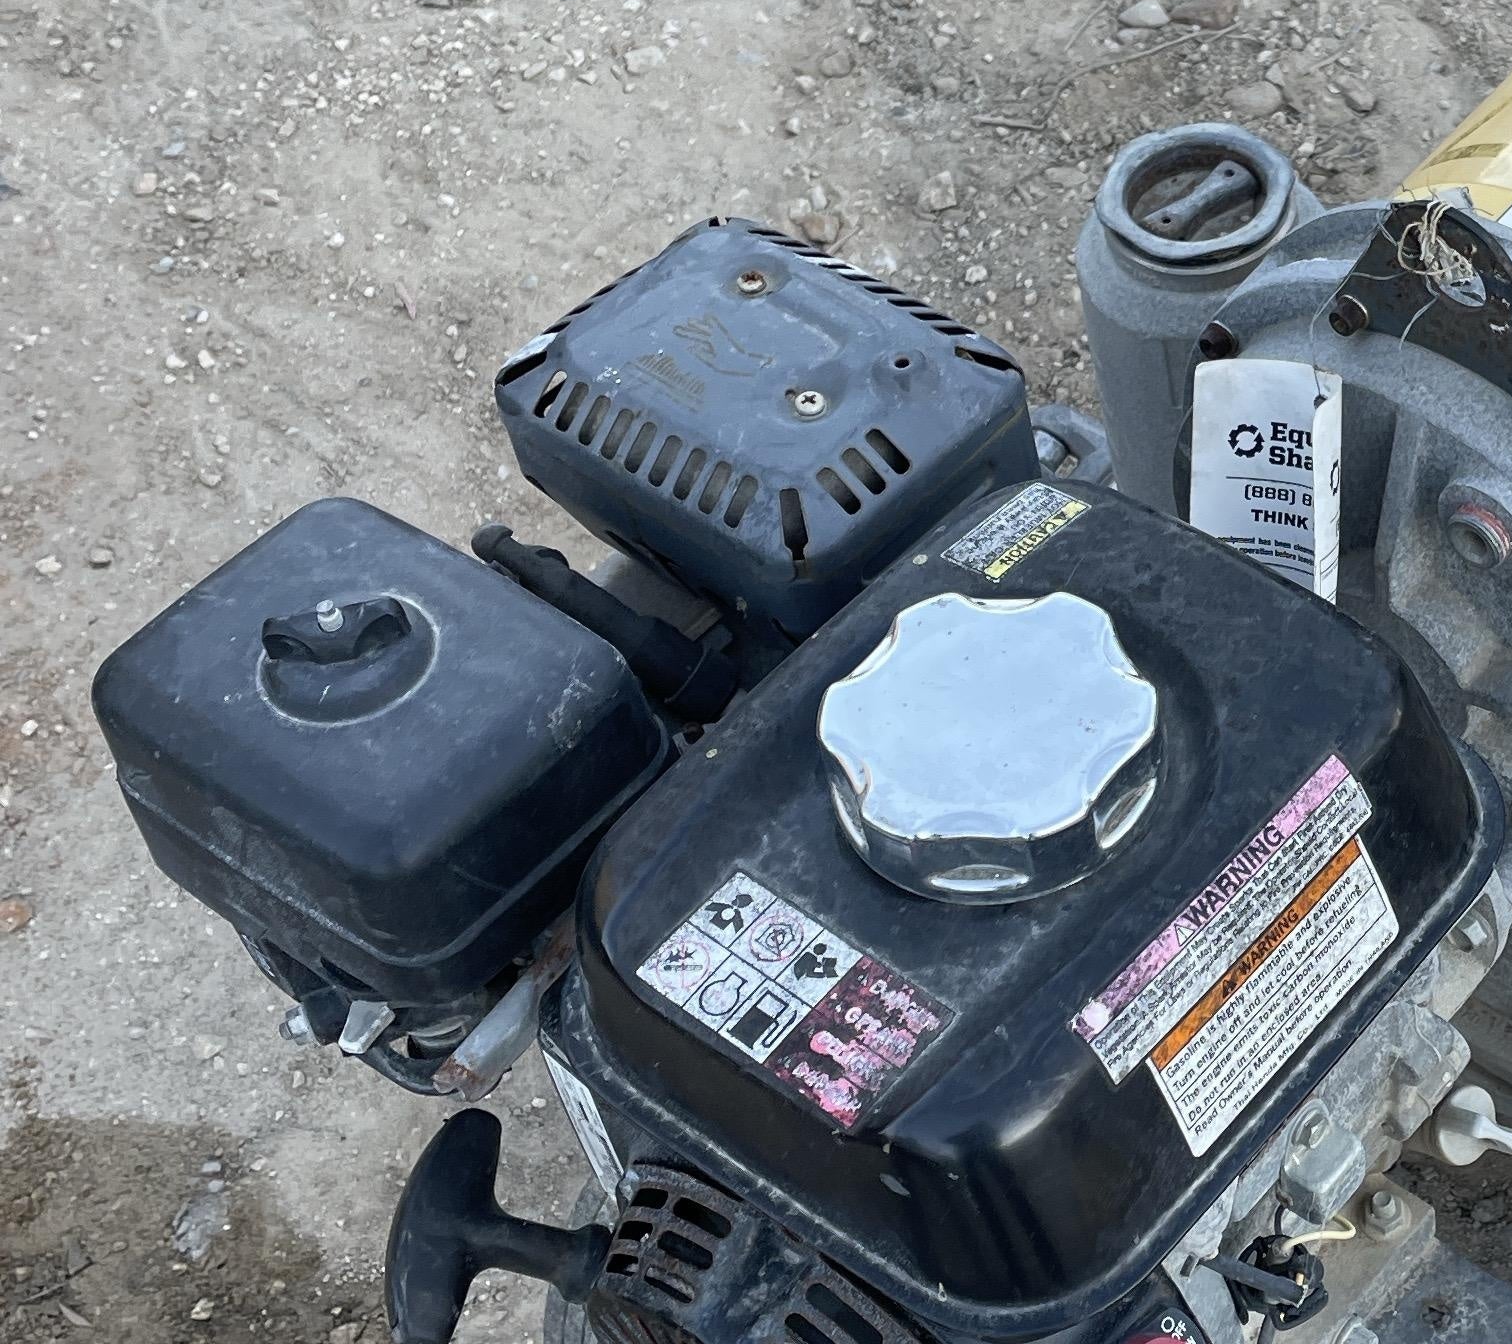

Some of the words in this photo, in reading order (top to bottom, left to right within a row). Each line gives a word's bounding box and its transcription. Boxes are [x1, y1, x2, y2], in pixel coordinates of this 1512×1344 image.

[996, 520, 1059, 567] CAUTION
[1245, 484, 1296, 506] (888)
[1251, 509, 1309, 531] THINK
[1183, 821, 1285, 931] WARNING
[1165, 1031, 1206, 1081] Gasoline
[1205, 1020, 1216, 1037] is
[1215, 989, 1246, 1028] highly
[1244, 936, 1294, 995] flammable
[1293, 917, 1312, 942] and
[1237, 906, 1299, 979] WARNING
[1172, 1064, 1195, 1094] Turn
[1195, 1030, 1228, 1071] engine
[1227, 1013, 1242, 1034] off
[1241, 993, 1260, 1018] and
[1260, 978, 1274, 998] let
[1274, 956, 1294, 983] cool
[1294, 924, 1324, 961] before
[1181, 1084, 1200, 1108] The
[1200, 1049, 1233, 1090] engine
[1231, 1020, 1258, 1053] emits
[1258, 995, 1281, 1024] toxic
[1281, 959, 1314, 999] carbon
[1187, 1102, 1202, 1122] Do
[1202, 1084, 1218, 1106] not
[1218, 1064, 1236, 1088] run
[1235, 1054, 1245, 1069] in
[1246, 1038, 1259, 1058] an
[1259, 994, 1300, 1043] enclosed
[1194, 1106, 1218, 1136] Read
[1217, 1067, 1253, 1110] Owner's
[1252, 1031, 1285, 1071] Manual
[1285, 1000, 1313, 1036] before
